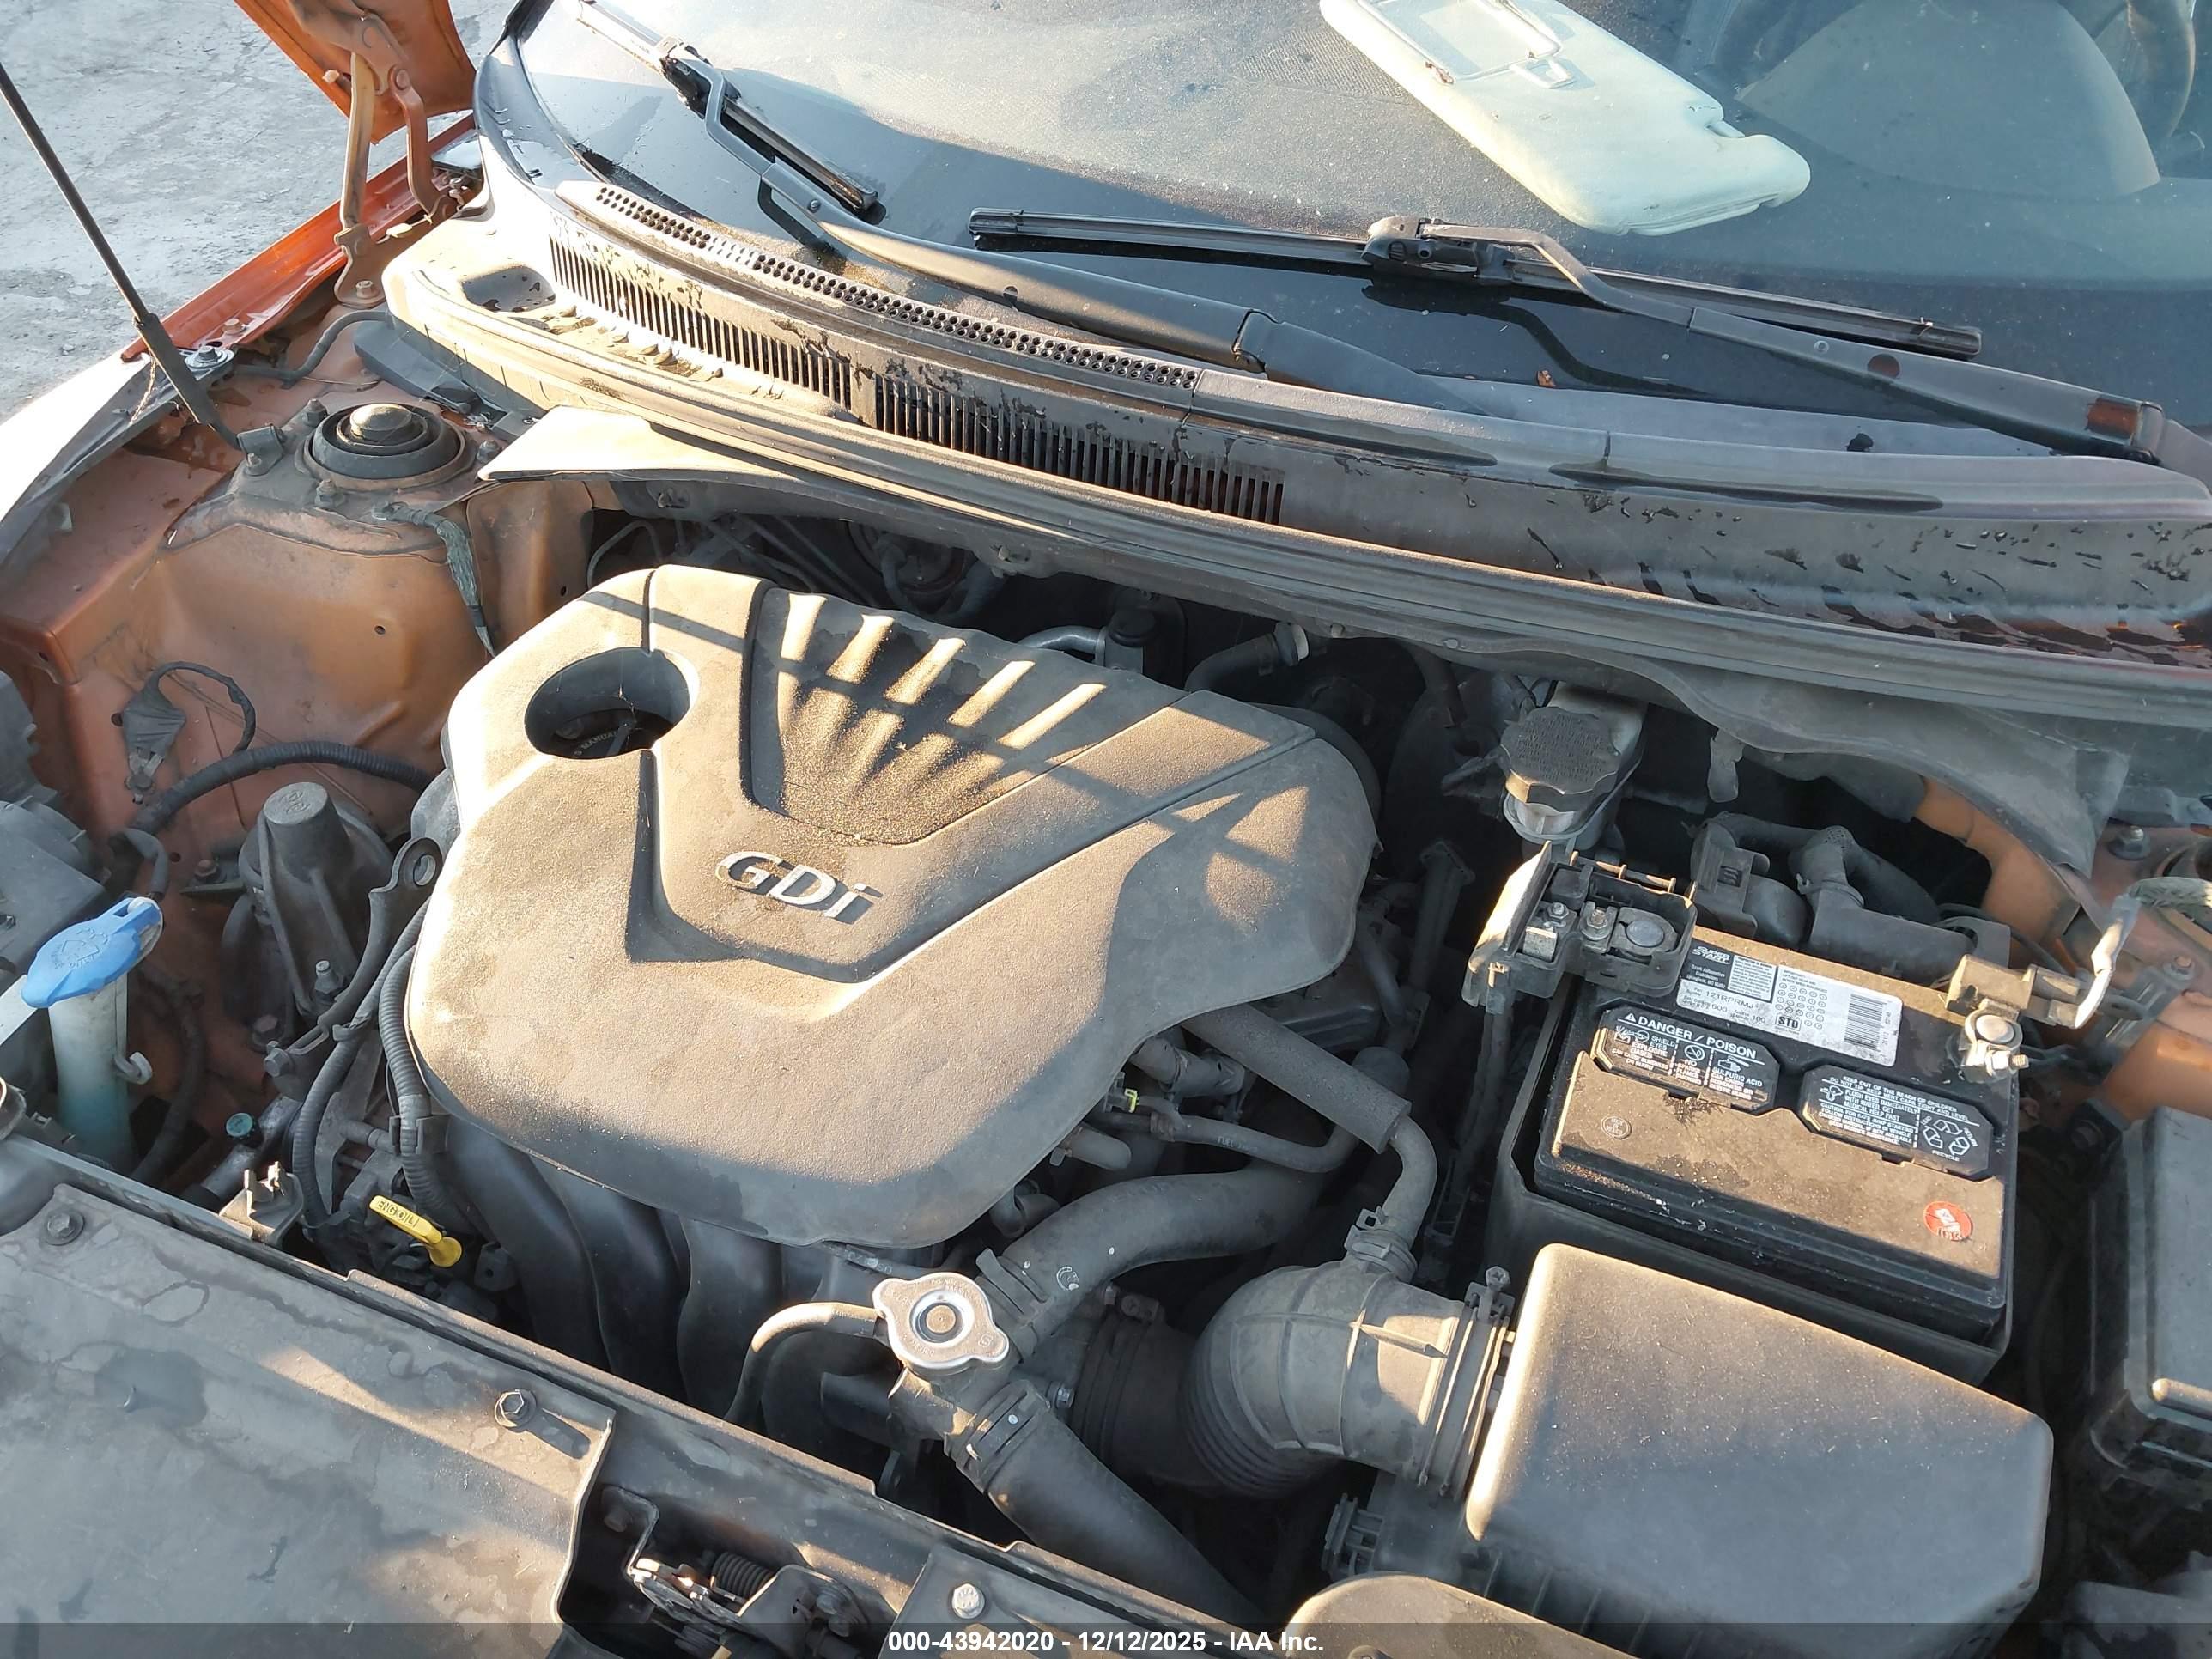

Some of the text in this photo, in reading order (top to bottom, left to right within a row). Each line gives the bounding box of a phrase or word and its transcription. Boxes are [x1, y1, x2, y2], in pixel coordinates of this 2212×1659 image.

[714, 851, 867, 919] GDi
[1697, 945, 1731, 960] SUPER
[1778, 1016, 1799, 1029] STD
[1638, 1016, 1692, 1040] DANGER
[1706, 1036, 1756, 1060] POISON
[1650, 1035, 1675, 1048] SHIELD
[1650, 1042, 1668, 1051] EYES
[1632, 1041, 1668, 1057] EXPLOSIVE
[1684, 1059, 1698, 1067] NO
[1711, 1066, 1763, 1087] SULFURIC ACID
[1840, 1079, 1853, 1088] NOT
[1866, 1086, 1882, 1096] KEEP
[1883, 1091, 1899, 1100] VENT
[1917, 1103, 1936, 1112] TIGHT
[1936, 1107, 1950, 1115] AND
[1843, 1076, 1858, 1085] KEEP
[1883, 1086, 1895, 1095] THE
[1896, 1091, 1916, 1100] REACH
[1927, 1100, 1957, 1112] CHILDREN
[1844, 1089, 1917, 1114] FLUSH EYES IMMEDIATELY
[1821, 1107, 1844, 1119] FOLLOW
[1844, 1095, 1859, 1103] WITH
[1882, 1104, 1894, 1114] GET
[1844, 1101, 1900, 1121] MEDICAL HELP FAST
[1887, 1121, 1914, 1133] STARTING
[1932, 1149, 1960, 1162] RECYCLE
[378, 1201, 415, 1226] ENG OIL
